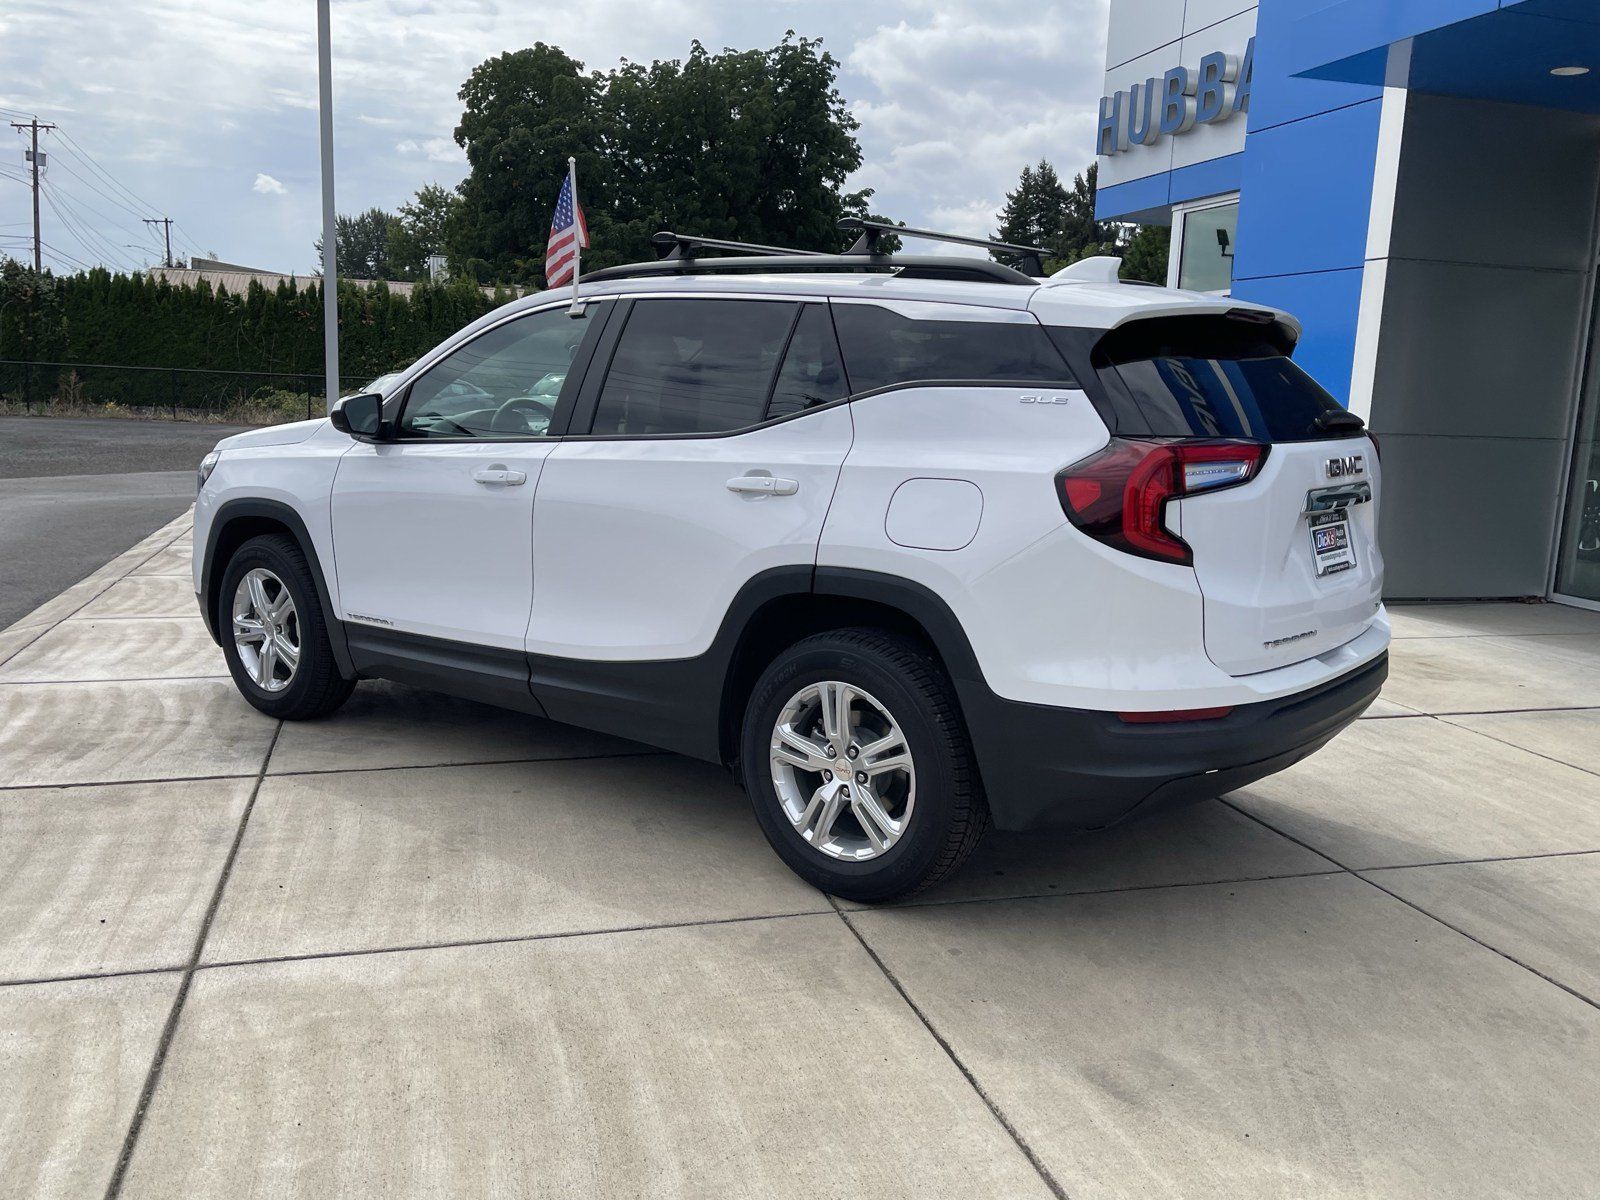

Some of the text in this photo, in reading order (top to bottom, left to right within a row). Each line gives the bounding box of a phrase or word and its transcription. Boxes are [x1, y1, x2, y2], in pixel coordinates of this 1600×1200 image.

[1019, 395, 1068, 405] SLE
[1326, 456, 1363, 477] GMC
[1317, 531, 1335, 548] Dick's
